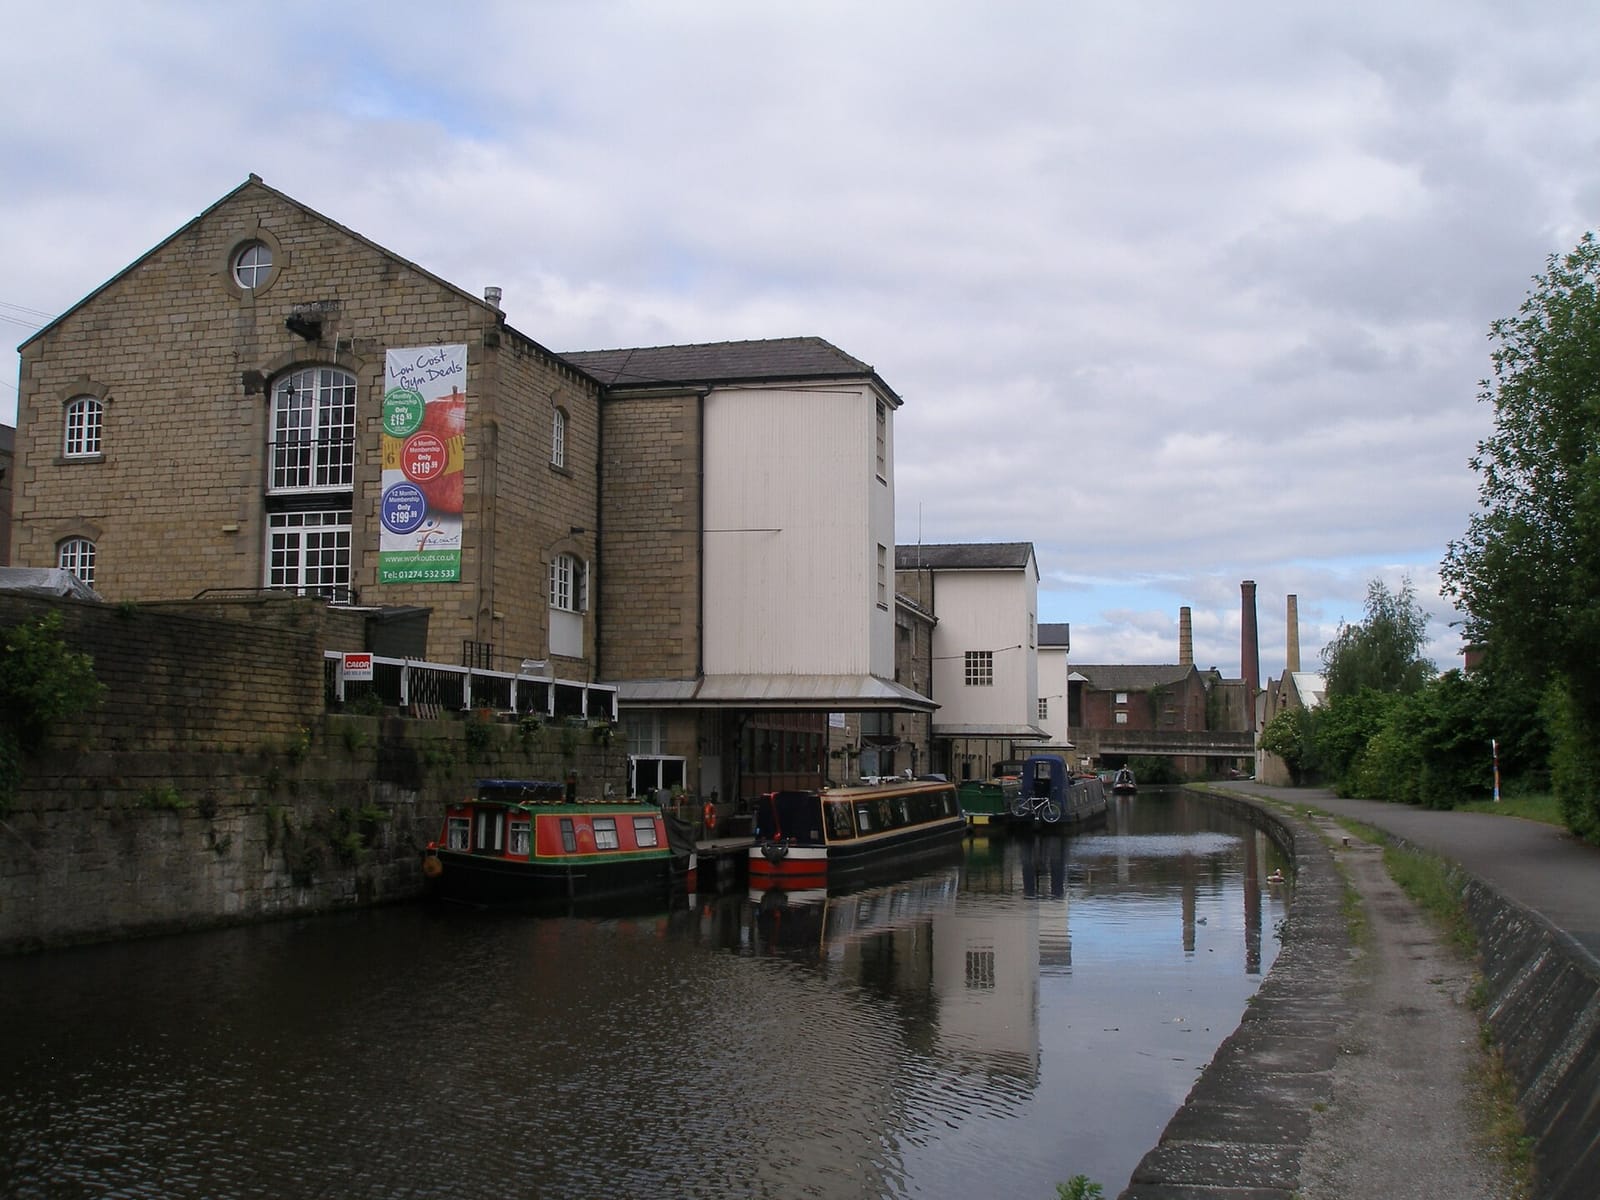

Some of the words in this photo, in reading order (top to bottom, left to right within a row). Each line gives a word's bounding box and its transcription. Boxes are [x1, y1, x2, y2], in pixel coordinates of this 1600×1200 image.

[390, 365, 414, 378] Low
[417, 349, 447, 368] Cost
[400, 376, 426, 392] Gym
[426, 361, 463, 381] Deals
[387, 453, 395, 464] 6
[385, 554, 455, 562] www.workouts.co.uk
[383, 571, 398, 579] Tel:
[398, 570, 422, 579] 01274
[424, 570, 439, 578] 532
[346, 661, 370, 670] CALOR
